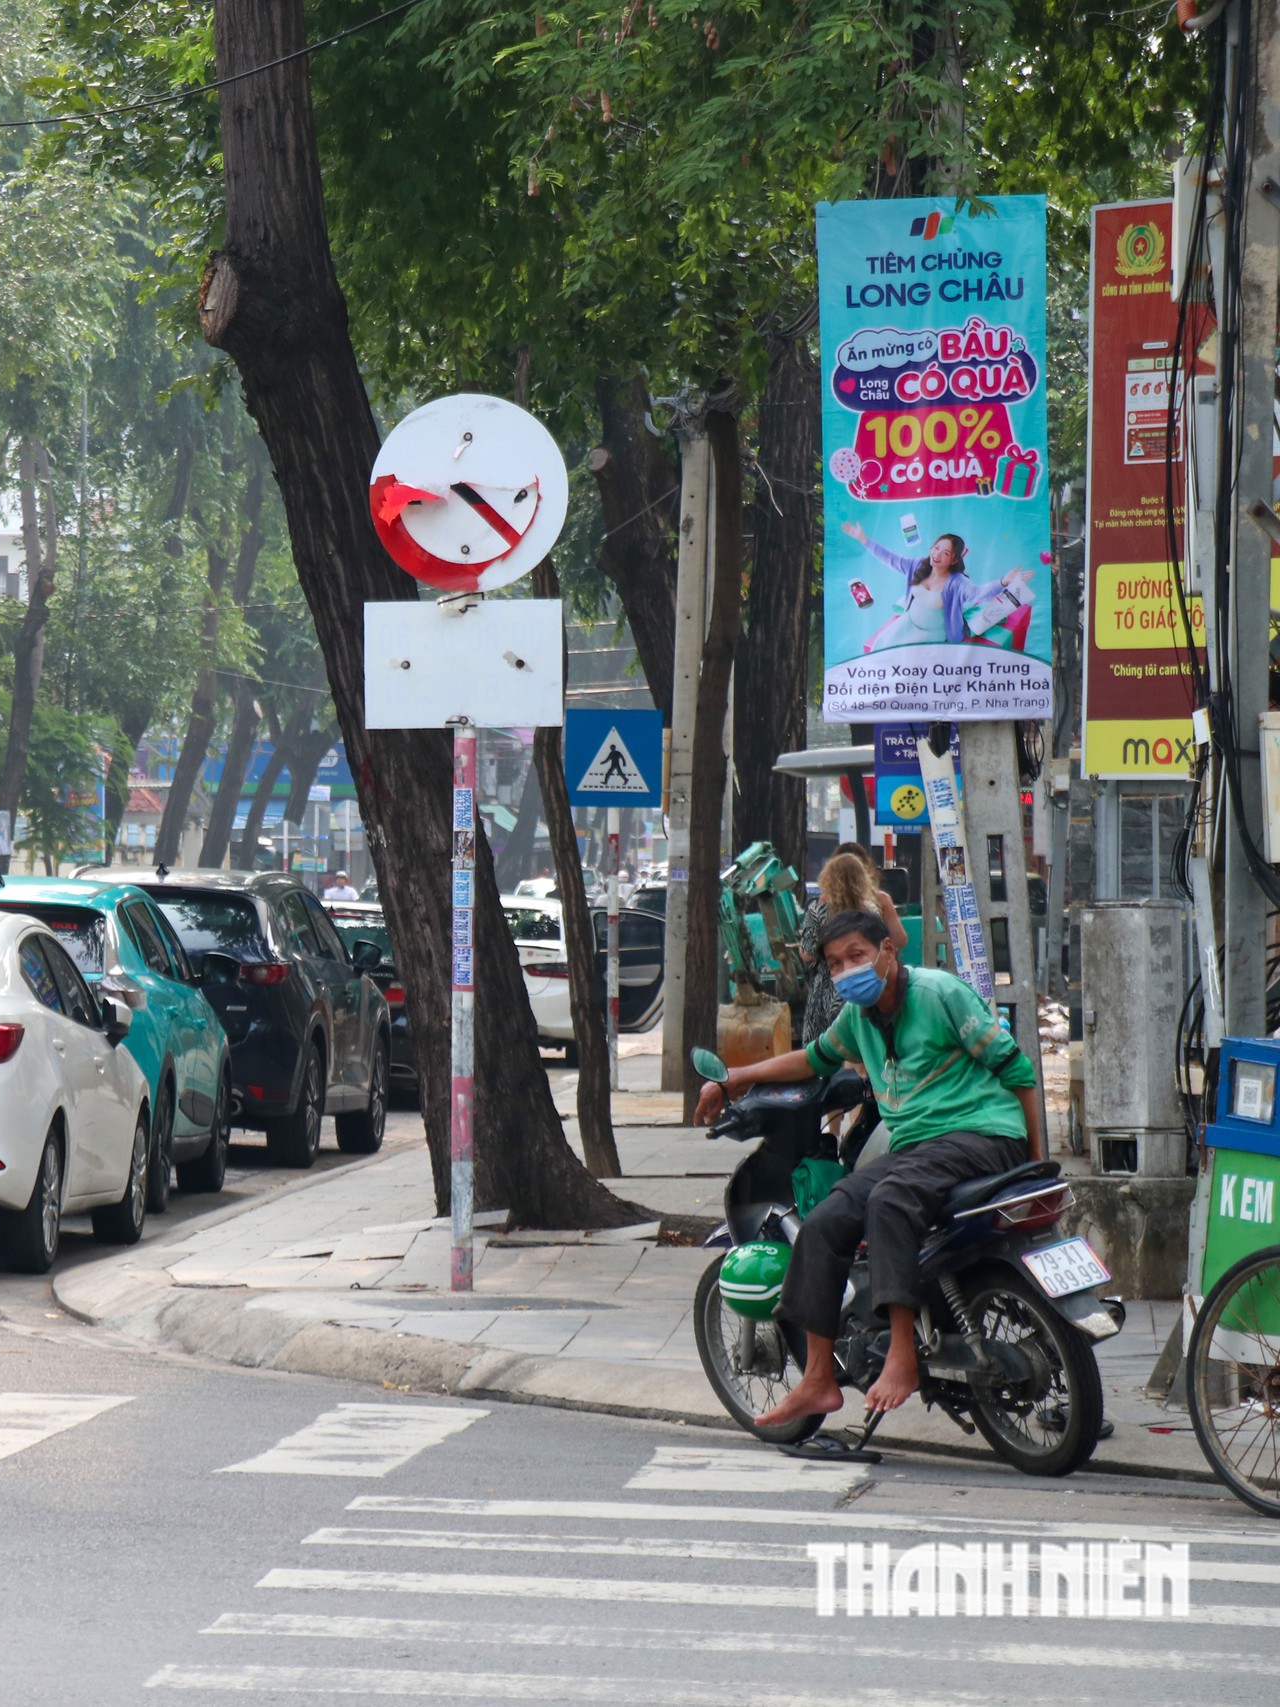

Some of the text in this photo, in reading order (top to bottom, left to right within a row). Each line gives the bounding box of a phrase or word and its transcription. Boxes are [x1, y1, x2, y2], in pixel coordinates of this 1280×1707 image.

[866, 247, 1002, 275] TIÊM CHỦNG
[846, 271, 1024, 309] LONG CHÂU
[1119, 284, 1127, 296] AN
[1143, 280, 1164, 295] KHÁNH
[847, 320, 1008, 362] Ăn mừng có BẦU
[859, 378, 889, 390] Long
[897, 356, 1028, 401] CÓ QUÀ
[859, 390, 890, 400] Châu
[865, 408, 1001, 459] 100%
[890, 451, 983, 484] CÓ QUÀ
[1117, 575, 1173, 600] ĐƯỜNG
[1114, 604, 1135, 630] TỐ
[1140, 605, 1177, 630] GIÁC
[847, 661, 1031, 680] Vòng Xoay Quang Trung
[1145, 663, 1157, 676] tôi
[1159, 665, 1178, 676] cam
[827, 678, 1050, 696] Đối diện Điện Lực Khánh Hoà
[827, 698, 848, 713] (Số
[890, 700, 929, 713] Quang
[932, 698, 968, 712] Trung,
[971, 698, 982, 709] P.
[985, 697, 1009, 709] Nha
[1012, 696, 1050, 710] Trang)
[51, 921, 78, 930] TAXI
[1219, 1172, 1274, 1224] KEM
[1033, 1244, 1084, 1273] 79-X1
[1042, 1261, 1104, 1294] 089.99
